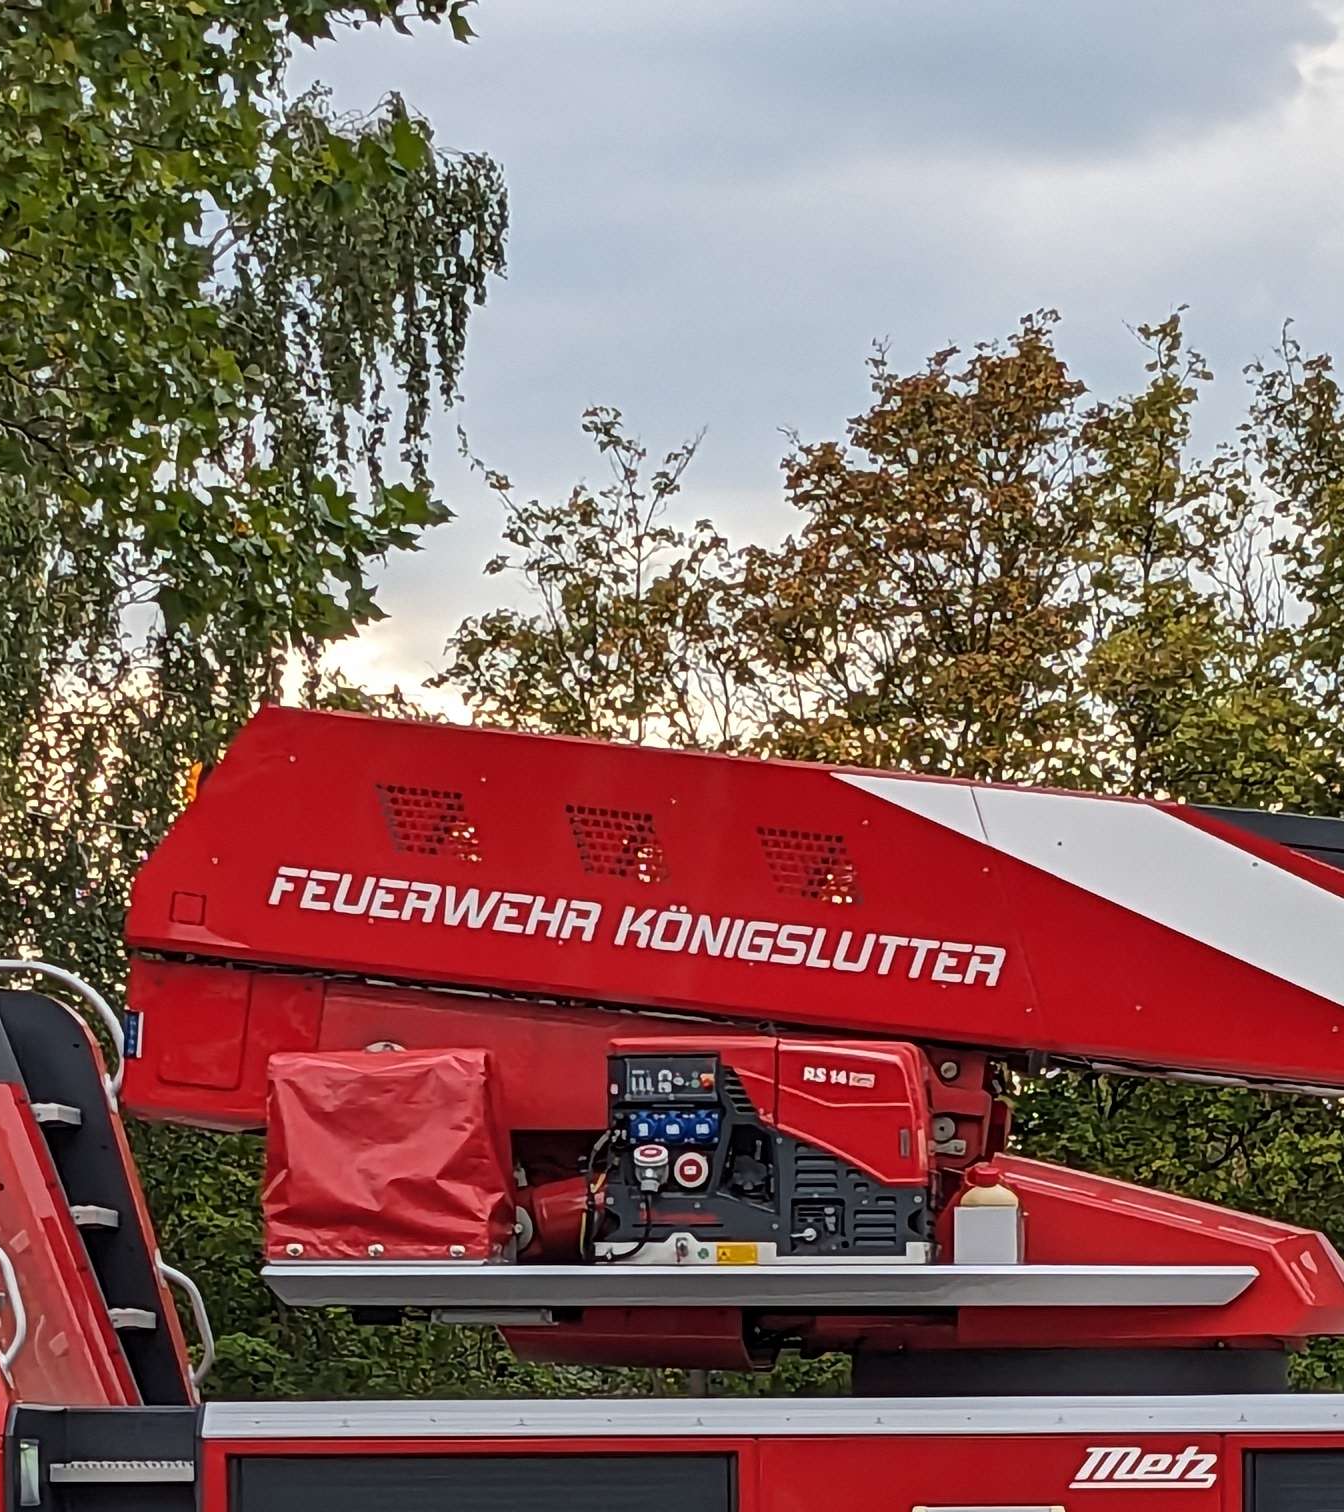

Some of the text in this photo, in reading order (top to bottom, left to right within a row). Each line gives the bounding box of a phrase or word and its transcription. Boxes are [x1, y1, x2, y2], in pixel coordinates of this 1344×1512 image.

[268, 866, 1007, 987] FEUERWEHR KÖNIGSLUTTER
[803, 1066, 827, 1083] RS
[829, 1069, 848, 1085] 14
[1068, 1446, 1218, 1489] Metz
